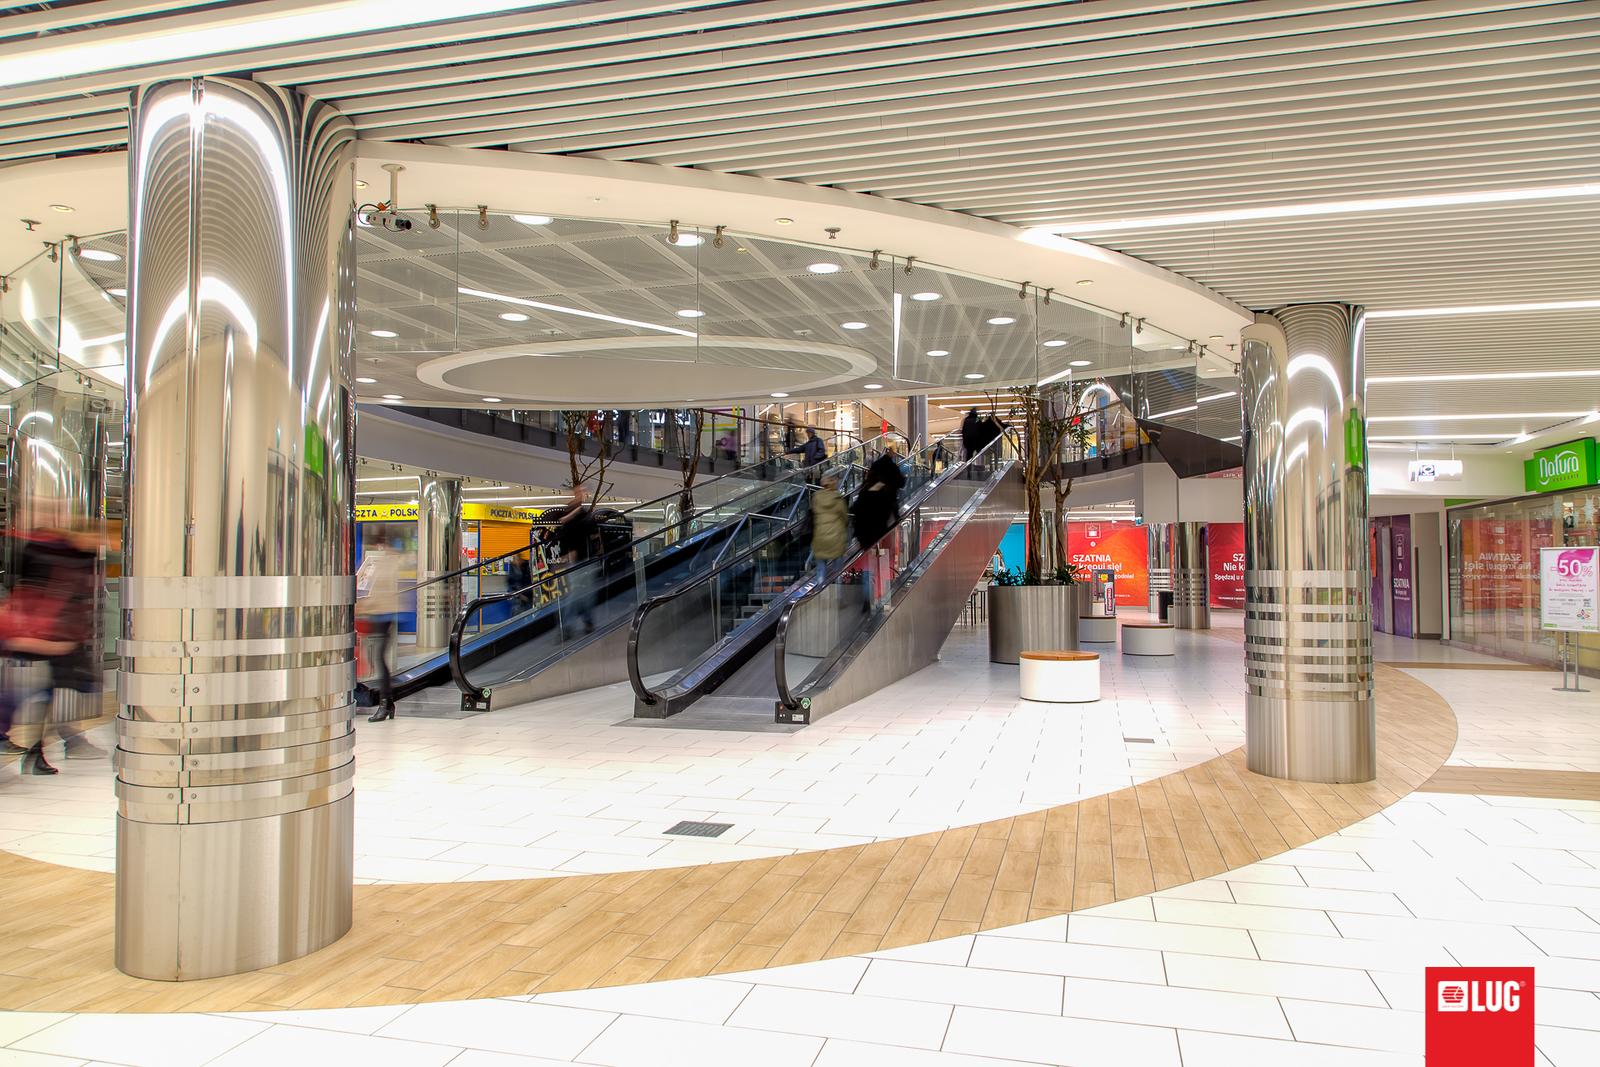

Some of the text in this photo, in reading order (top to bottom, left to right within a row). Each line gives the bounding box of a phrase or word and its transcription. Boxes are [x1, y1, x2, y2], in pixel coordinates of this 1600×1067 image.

[356, 508, 417, 517] CZTA POLSK
[1073, 554, 1111, 562] SZATNIA
[1223, 562, 1237, 571] Nie
